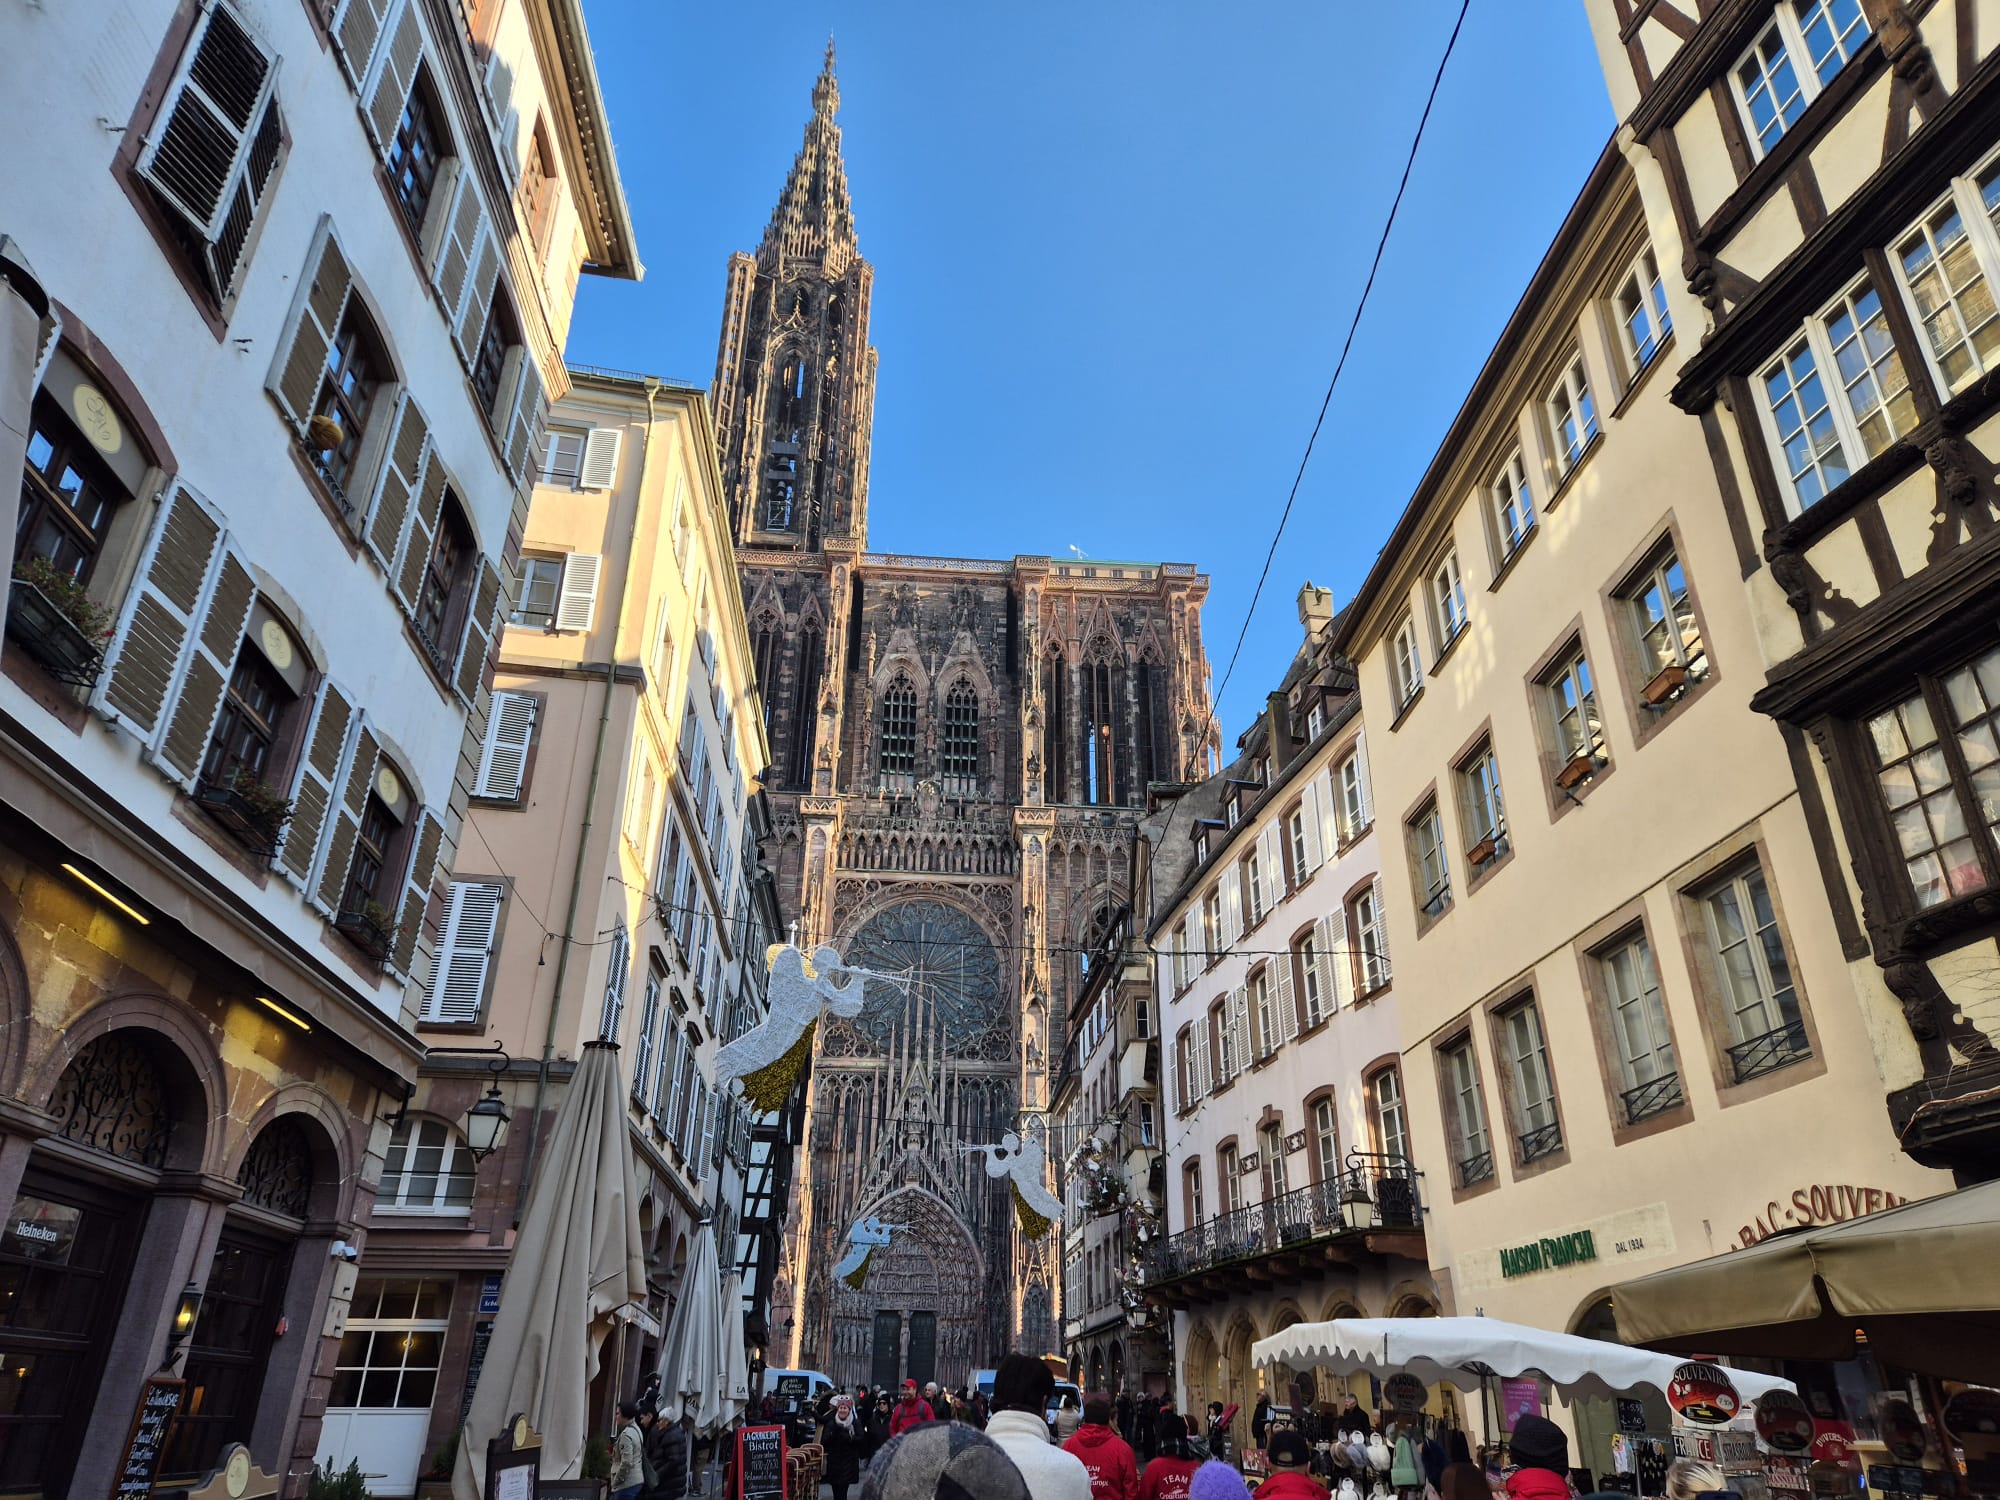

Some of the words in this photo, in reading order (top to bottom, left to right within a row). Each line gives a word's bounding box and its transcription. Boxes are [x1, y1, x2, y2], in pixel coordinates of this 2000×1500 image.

[17, 1221, 57, 1242] Heineken
[1500, 1243, 1542, 1278] MAISON
[1540, 1230, 1597, 1269] FRANCHI
[1615, 1242, 1628, 1253] DAL
[1628, 1238, 1645, 1251] 1934
[1673, 1365, 1729, 1388] SOUVENIRS
[749, 1440, 778, 1451] Bistrot
[1673, 1435, 1712, 1460] FRANCE
[1163, 1474, 1188, 1485] TEAM
